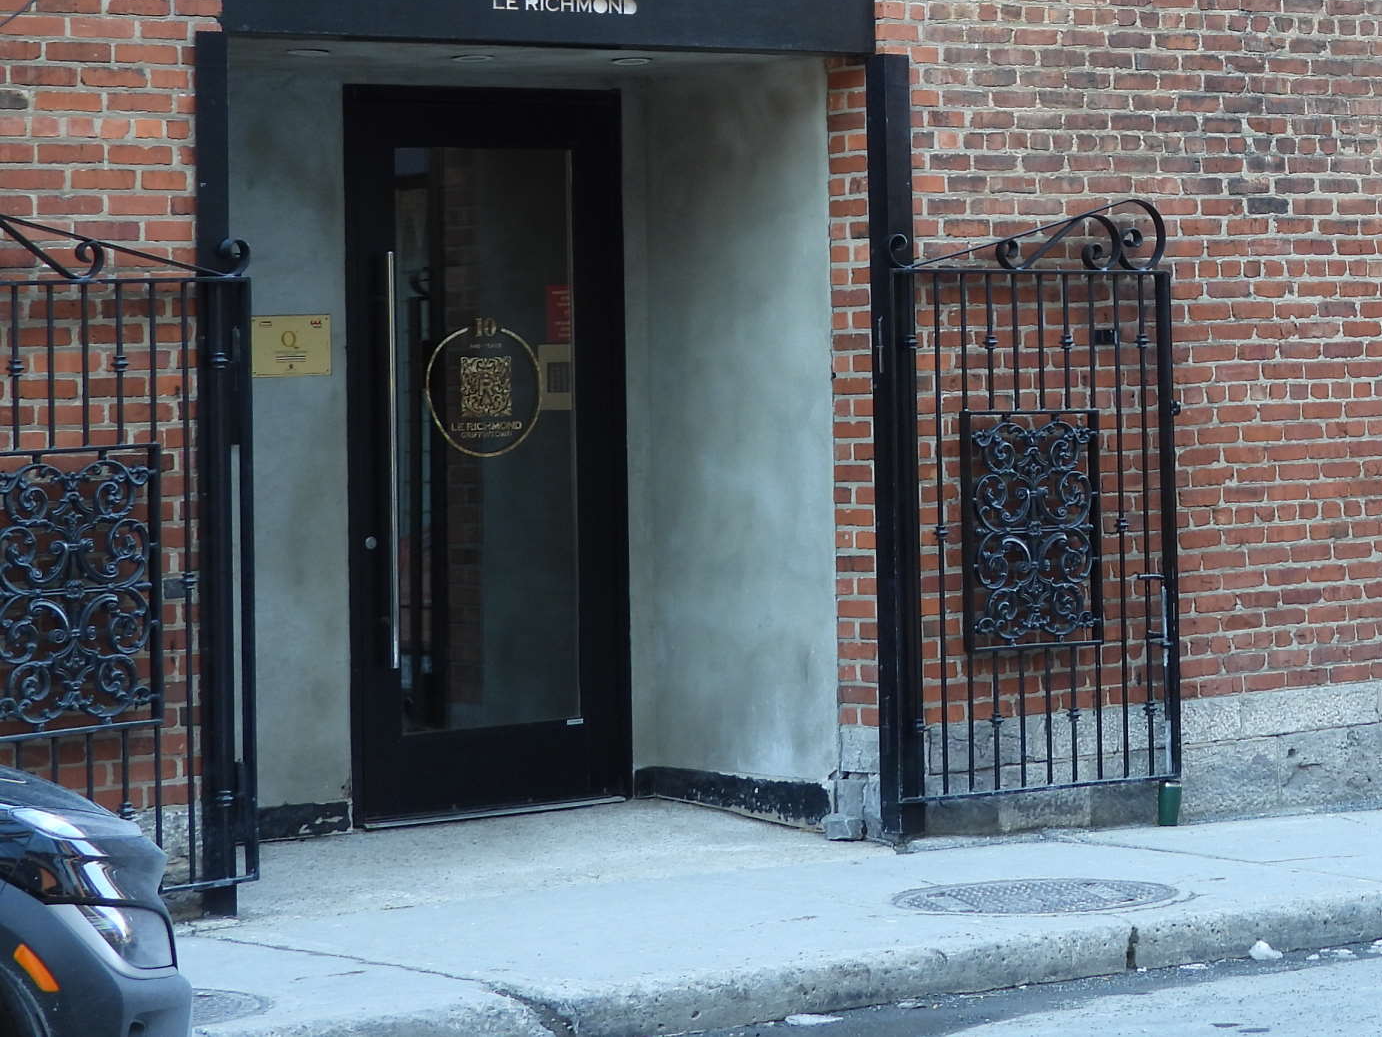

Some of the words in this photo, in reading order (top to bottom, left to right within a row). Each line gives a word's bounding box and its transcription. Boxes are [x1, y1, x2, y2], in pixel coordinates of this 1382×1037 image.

[475, 318, 497, 337] 10
[451, 423, 465, 431] LE
[466, 421, 522, 431] RICHMOND
